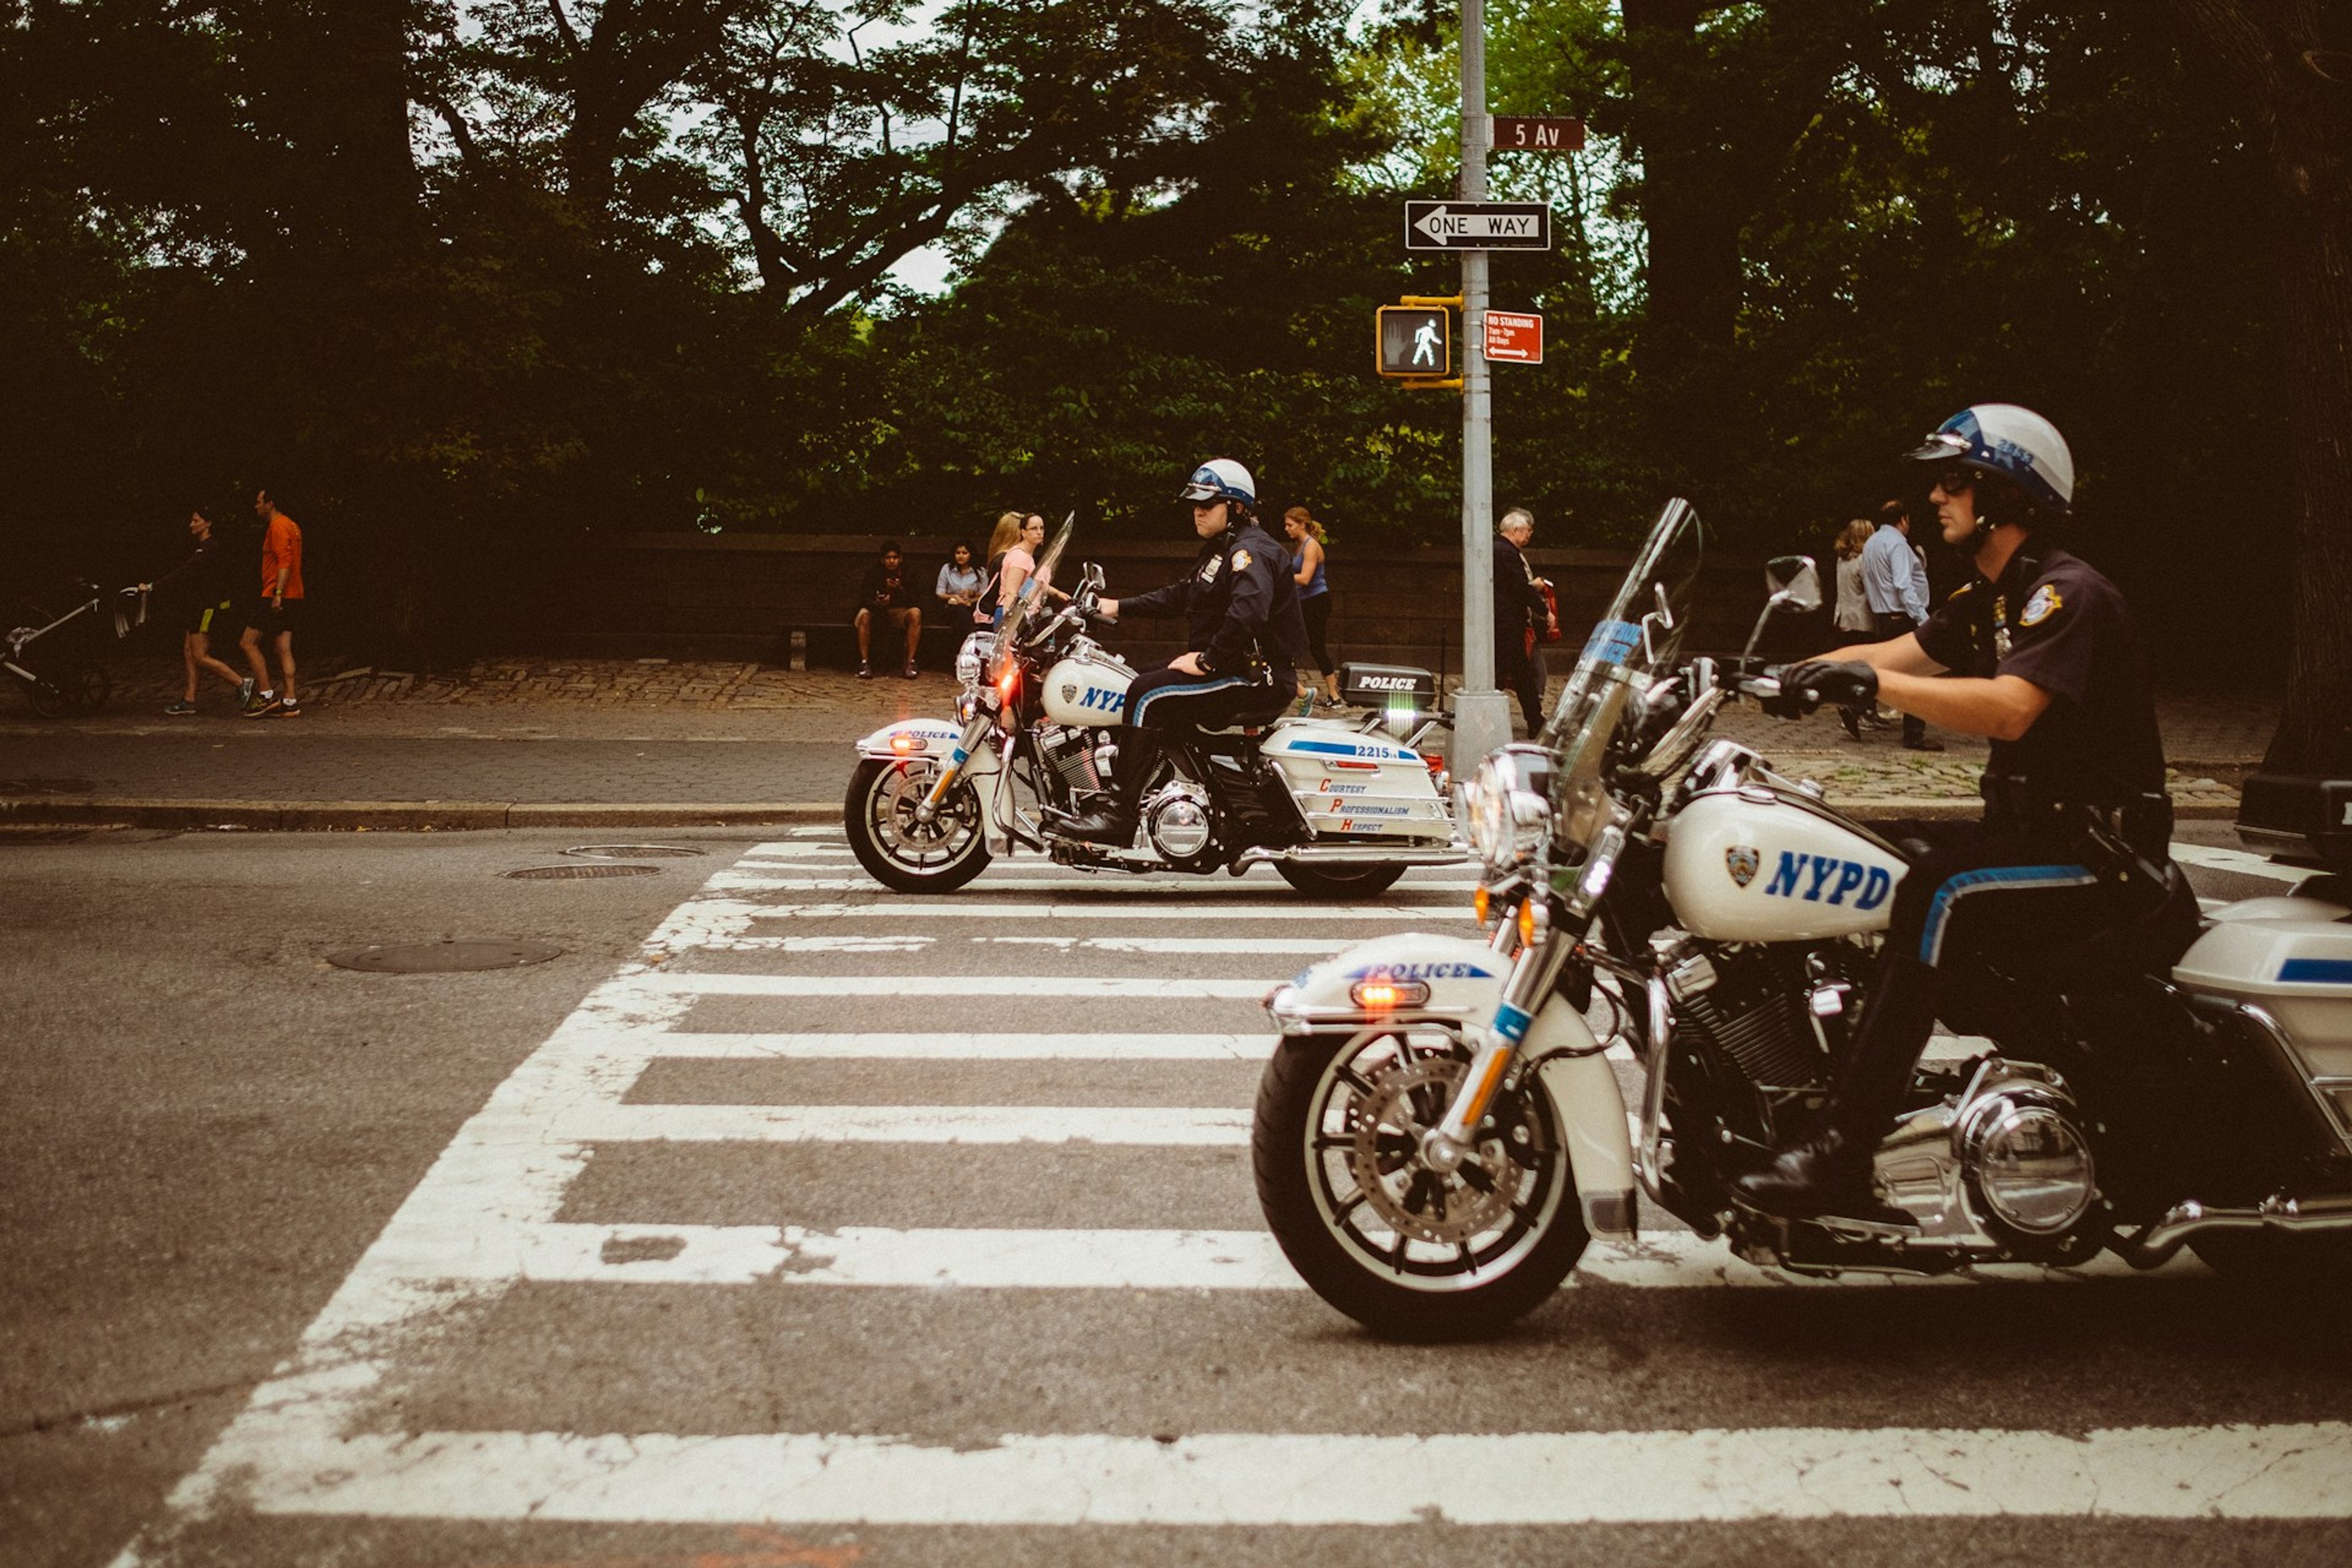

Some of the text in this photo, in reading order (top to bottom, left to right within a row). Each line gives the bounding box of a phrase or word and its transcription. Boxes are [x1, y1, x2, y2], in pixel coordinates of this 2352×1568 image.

[1516, 124, 1559, 146] 5 Av
[1430, 217, 1529, 234] ONE WAY
[1488, 316, 1534, 328] NO STANDING
[1359, 676, 1417, 691] POLICE
[1079, 687, 1126, 712] NYP
[1358, 746, 1389, 758] 2215
[1765, 851, 1891, 910] NYPD
[1375, 963, 1468, 979] POLICE
